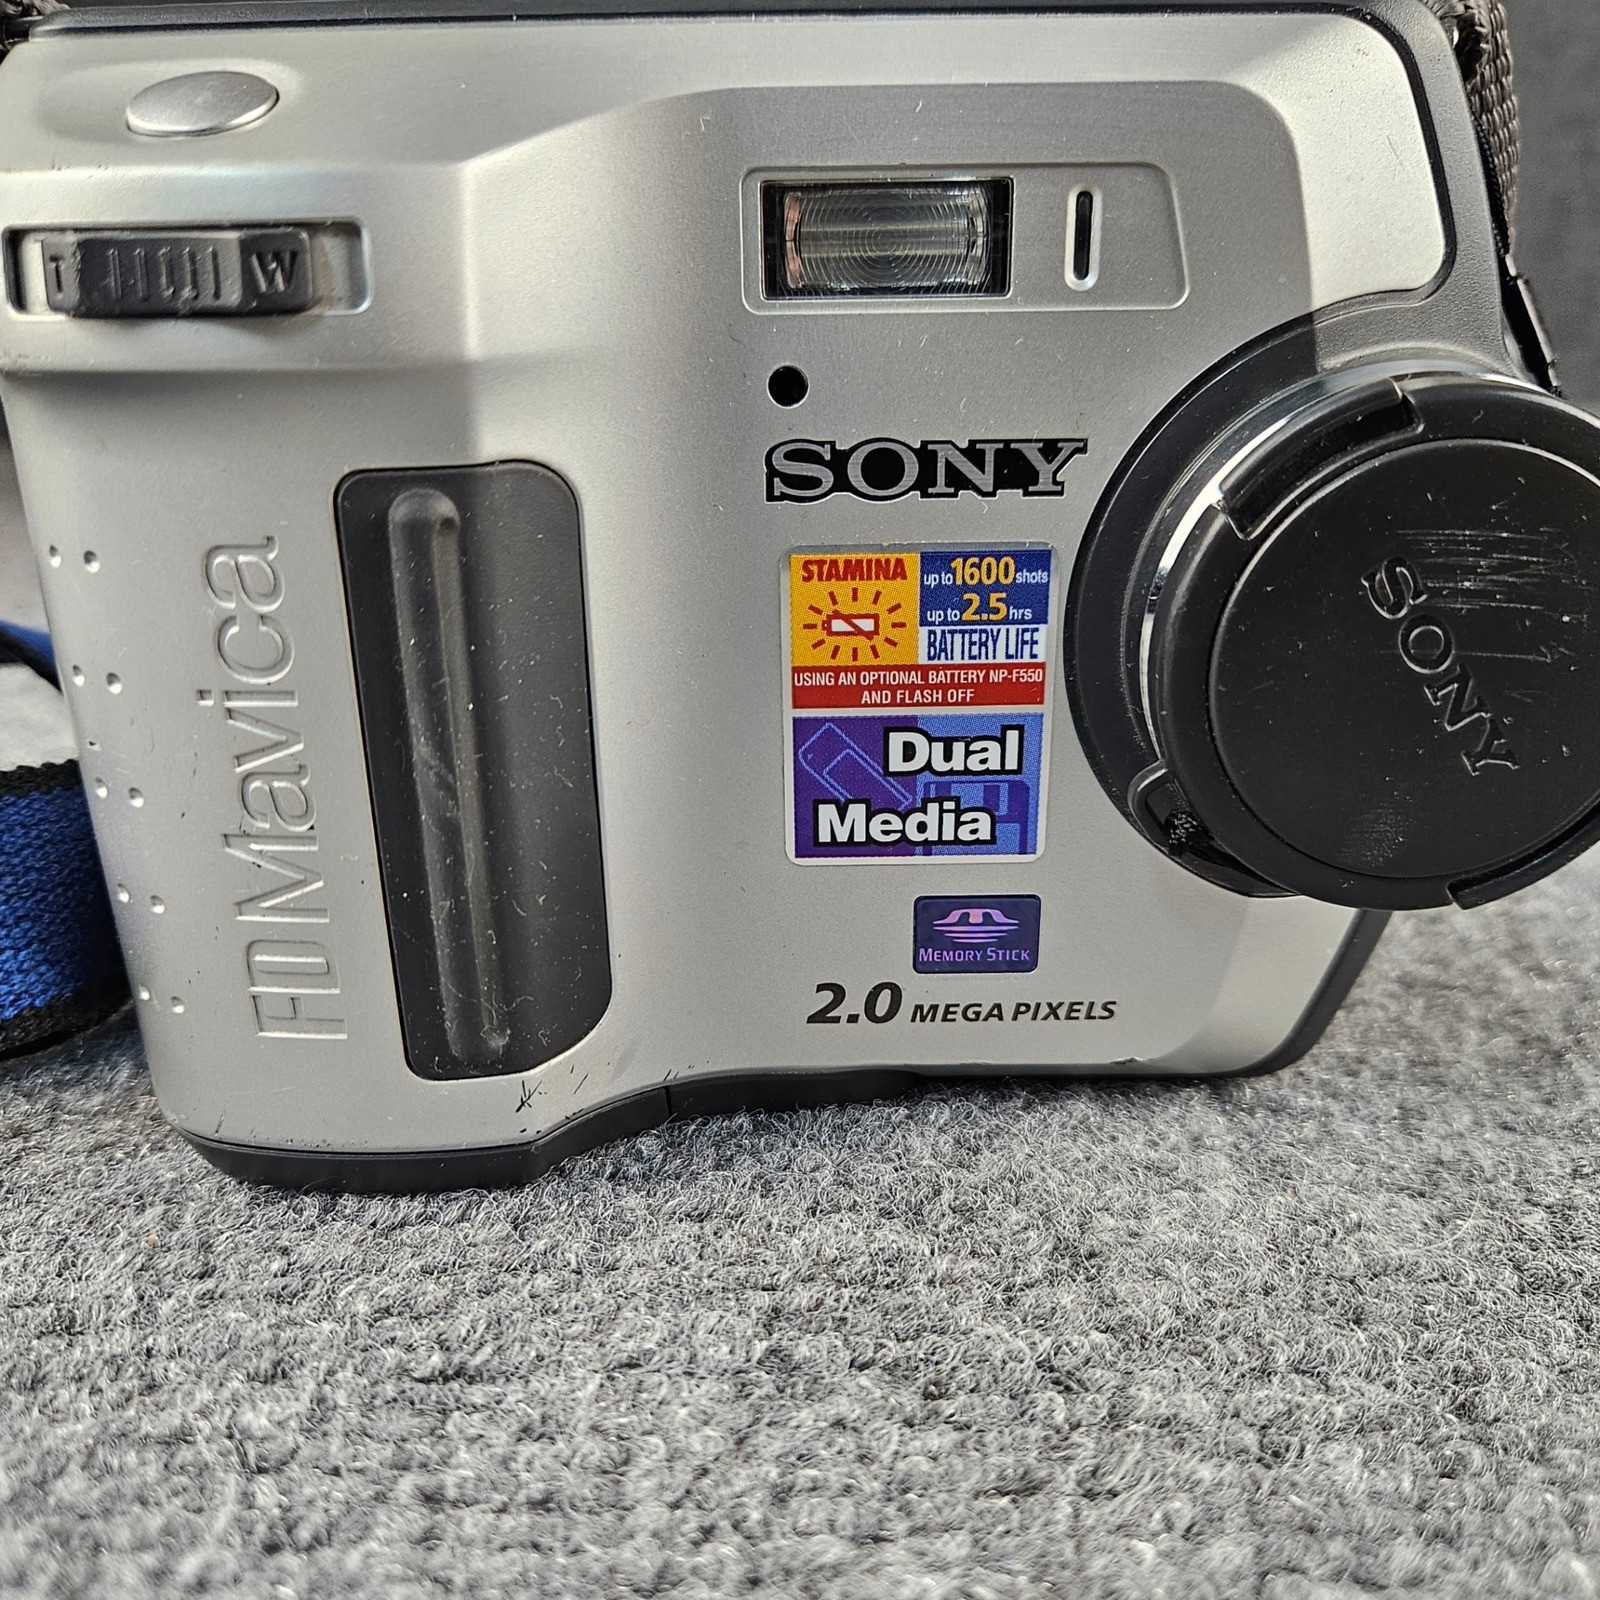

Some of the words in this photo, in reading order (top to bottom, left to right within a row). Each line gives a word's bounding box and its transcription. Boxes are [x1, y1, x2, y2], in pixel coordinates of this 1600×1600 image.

[251, 250, 298, 294] W
[768, 439, 1087, 500] SONY
[801, 558, 907, 582] STAMINA
[923, 573, 939, 588] up
[941, 572, 953, 585] to
[950, 556, 1016, 586] 1600
[1015, 569, 1049, 584] shots
[927, 610, 944, 625] up
[947, 607, 960, 622] to
[962, 593, 1007, 621] 2.5
[1009, 605, 1032, 619] hrs
[927, 629, 1000, 661] BATTERY
[1005, 628, 1039, 659] LIFE
[794, 672, 835, 686] USING
[838, 671, 857, 685] AN
[860, 670, 925, 684] OPTIONAL
[928, 669, 985, 683] BATTERY
[989, 668, 1043, 682] NP-F550
[1361, 557, 1520, 776] SONY
[861, 690, 892, 704] AND
[896, 689, 944, 703] FLASH
[948, 688, 975, 702] OFF
[198, 535, 330, 922] Mavica
[888, 729, 1020, 772] Dual
[818, 801, 992, 843] Media
[247, 940, 348, 1039] FD
[806, 982, 903, 1024] 2.0
[910, 1003, 1004, 1021] MEGA
[1011, 1001, 1117, 1020] PIXELS
